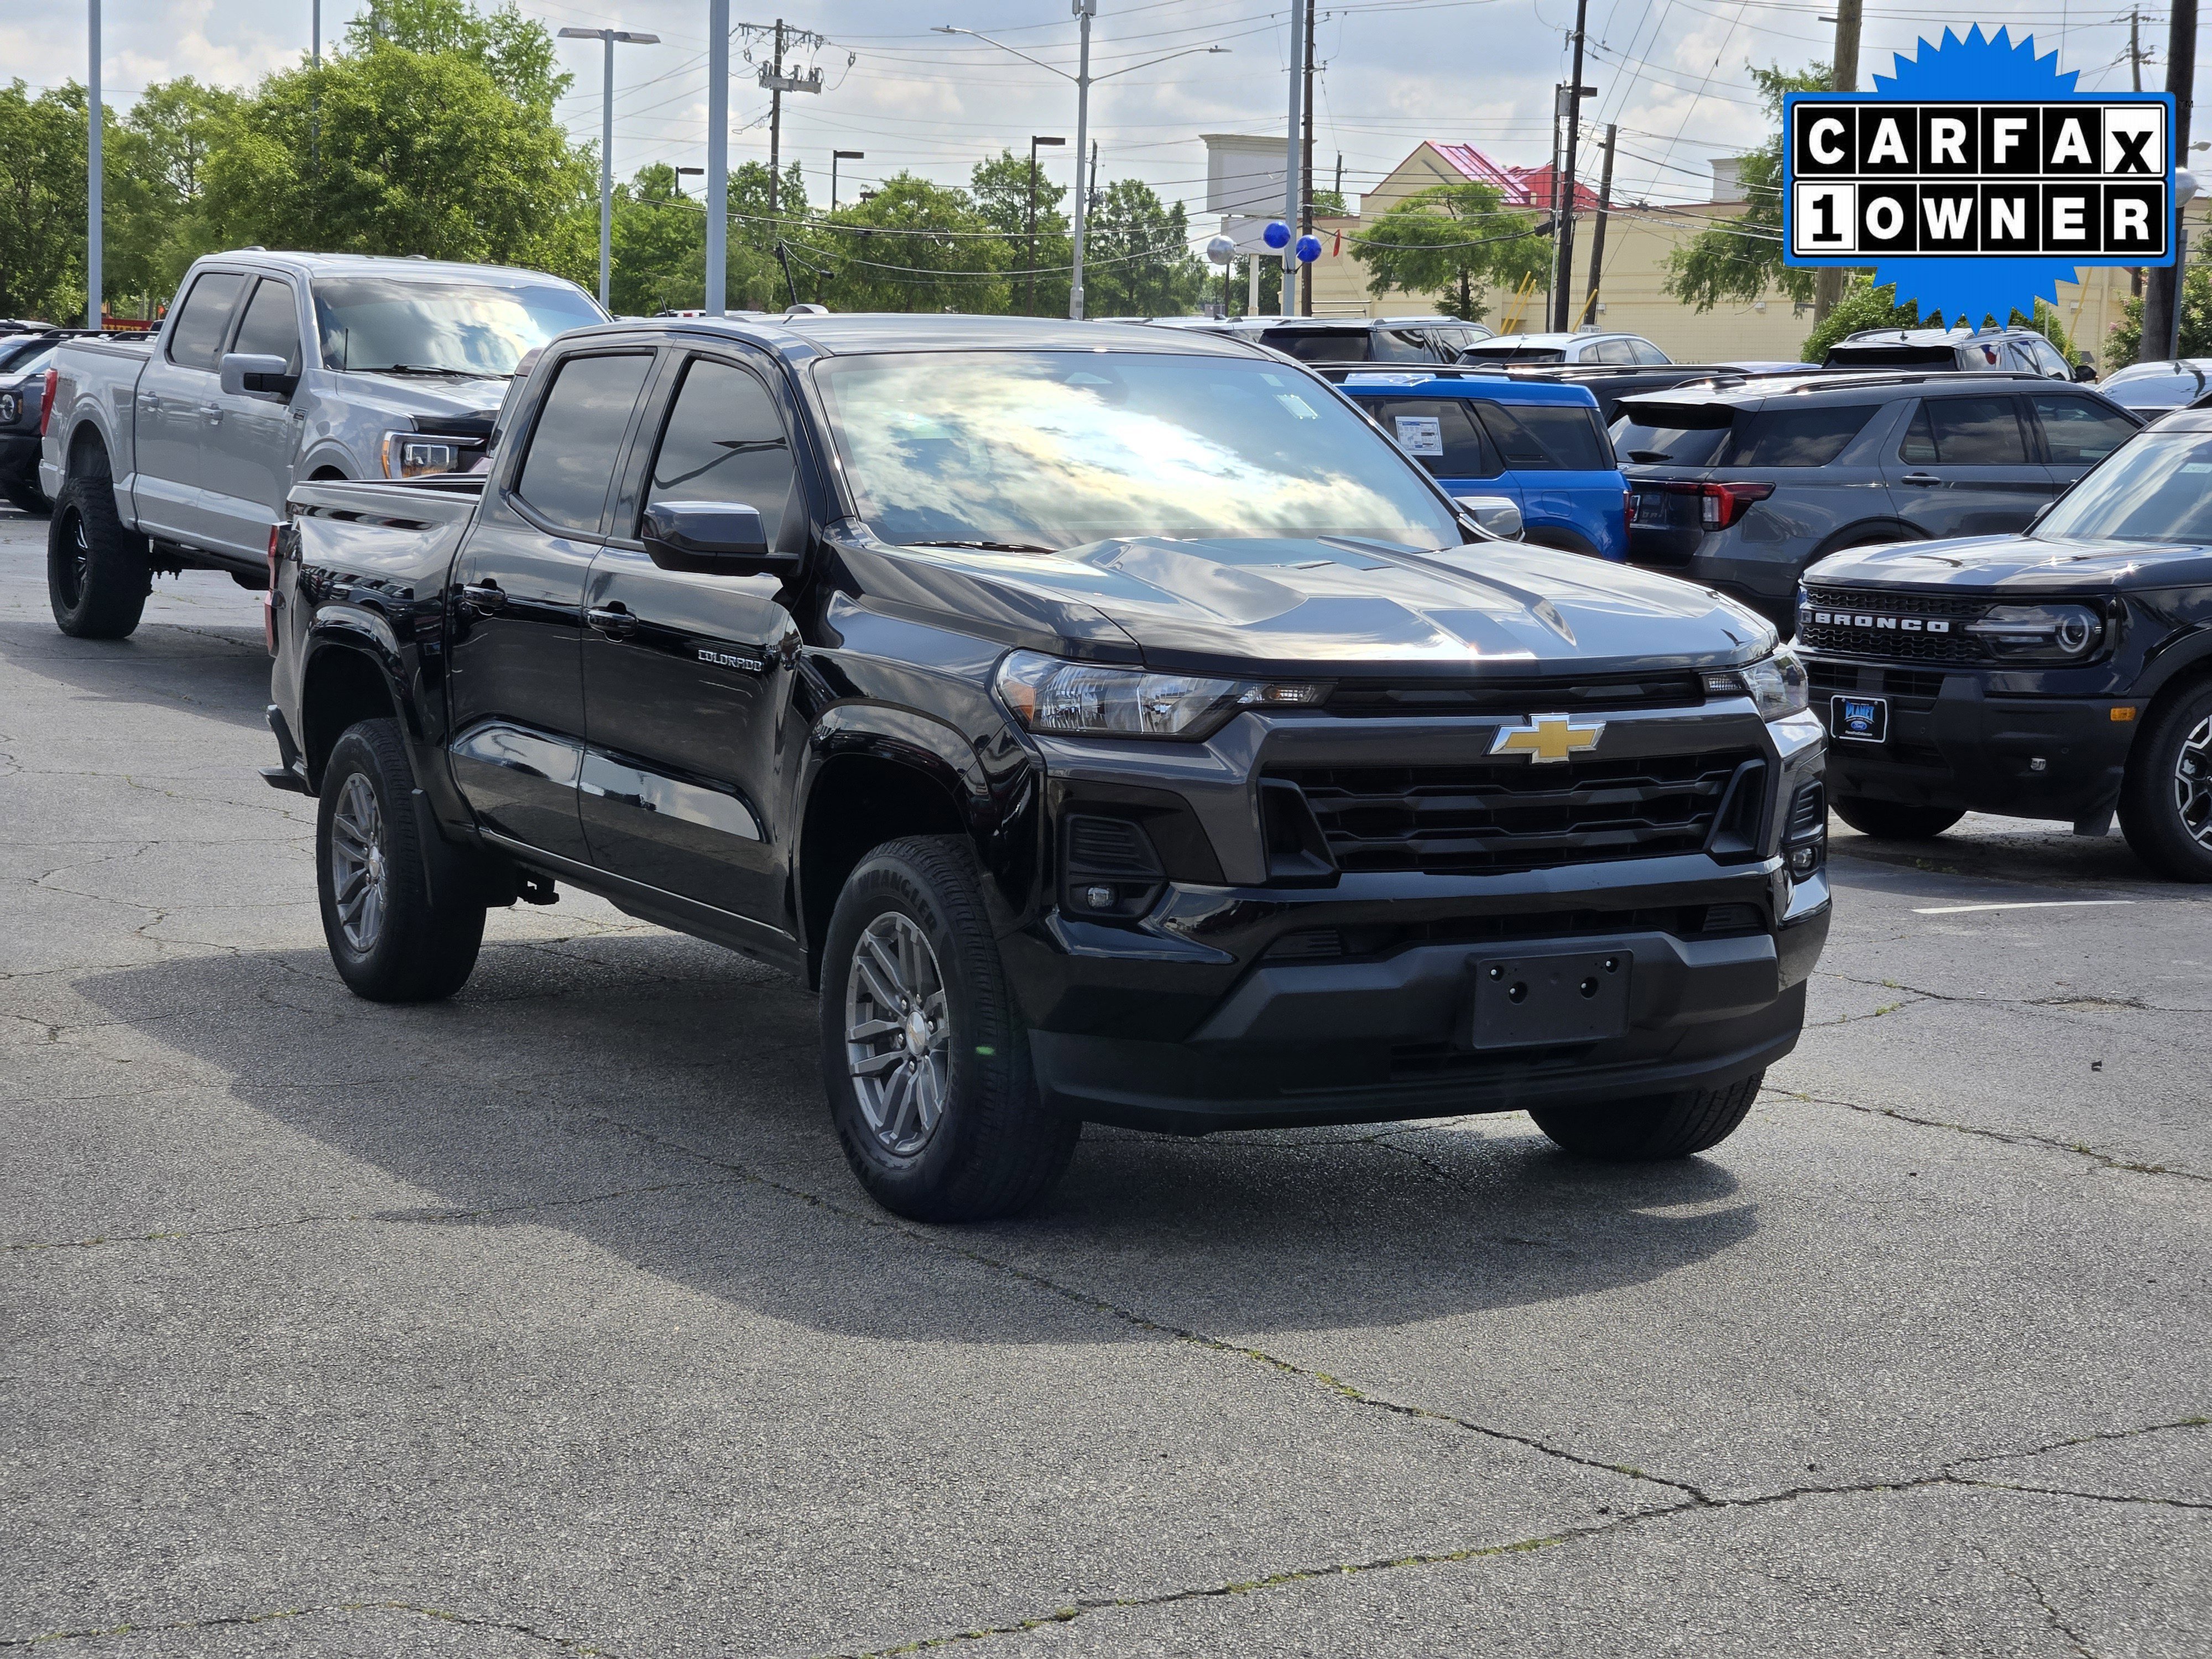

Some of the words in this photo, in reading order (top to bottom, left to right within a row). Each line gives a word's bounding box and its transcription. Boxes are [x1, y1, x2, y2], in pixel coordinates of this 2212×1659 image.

[1815, 612, 1949, 633] BRONCO
[698, 649, 762, 672] COLORADO
[1845, 701, 1875, 721] PLANET
[857, 869, 938, 935] WRANGLER
